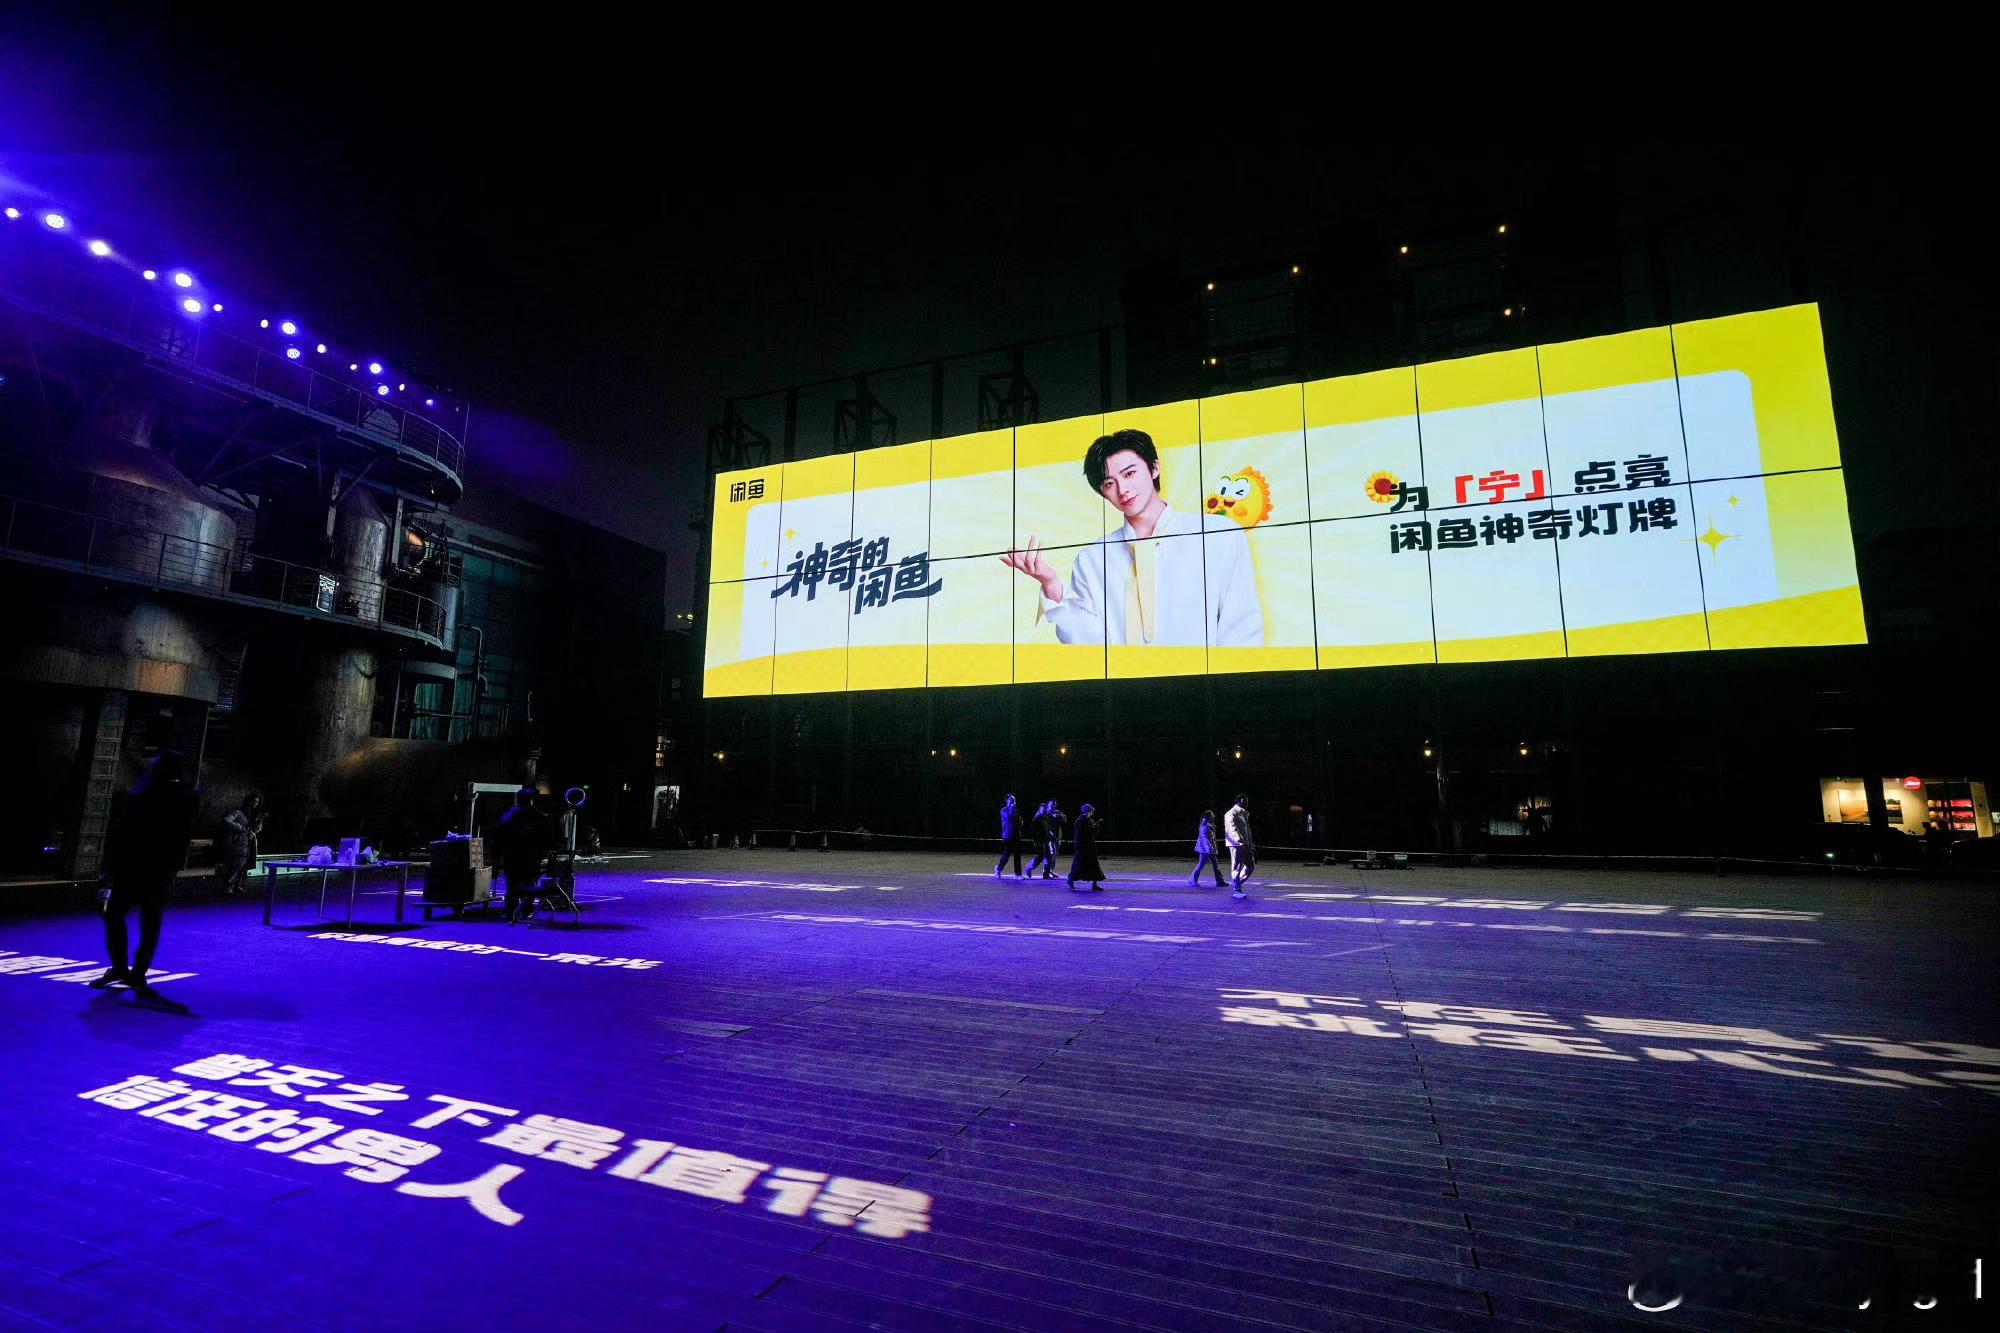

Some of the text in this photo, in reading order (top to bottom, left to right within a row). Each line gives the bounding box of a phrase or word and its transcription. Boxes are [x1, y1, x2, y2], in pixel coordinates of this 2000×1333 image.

[729, 478, 766, 502] 闲鱼
[1389, 497, 1678, 554] 闲鱼神奇灯牌
[770, 536, 890, 601] 神奇的
[854, 551, 943, 615] 闲鱼
[1219, 1006, 2000, 1091] 就在心
[77, 1074, 524, 1225] 信任的男人
[171, 1053, 935, 1238] 普天之下最值得
